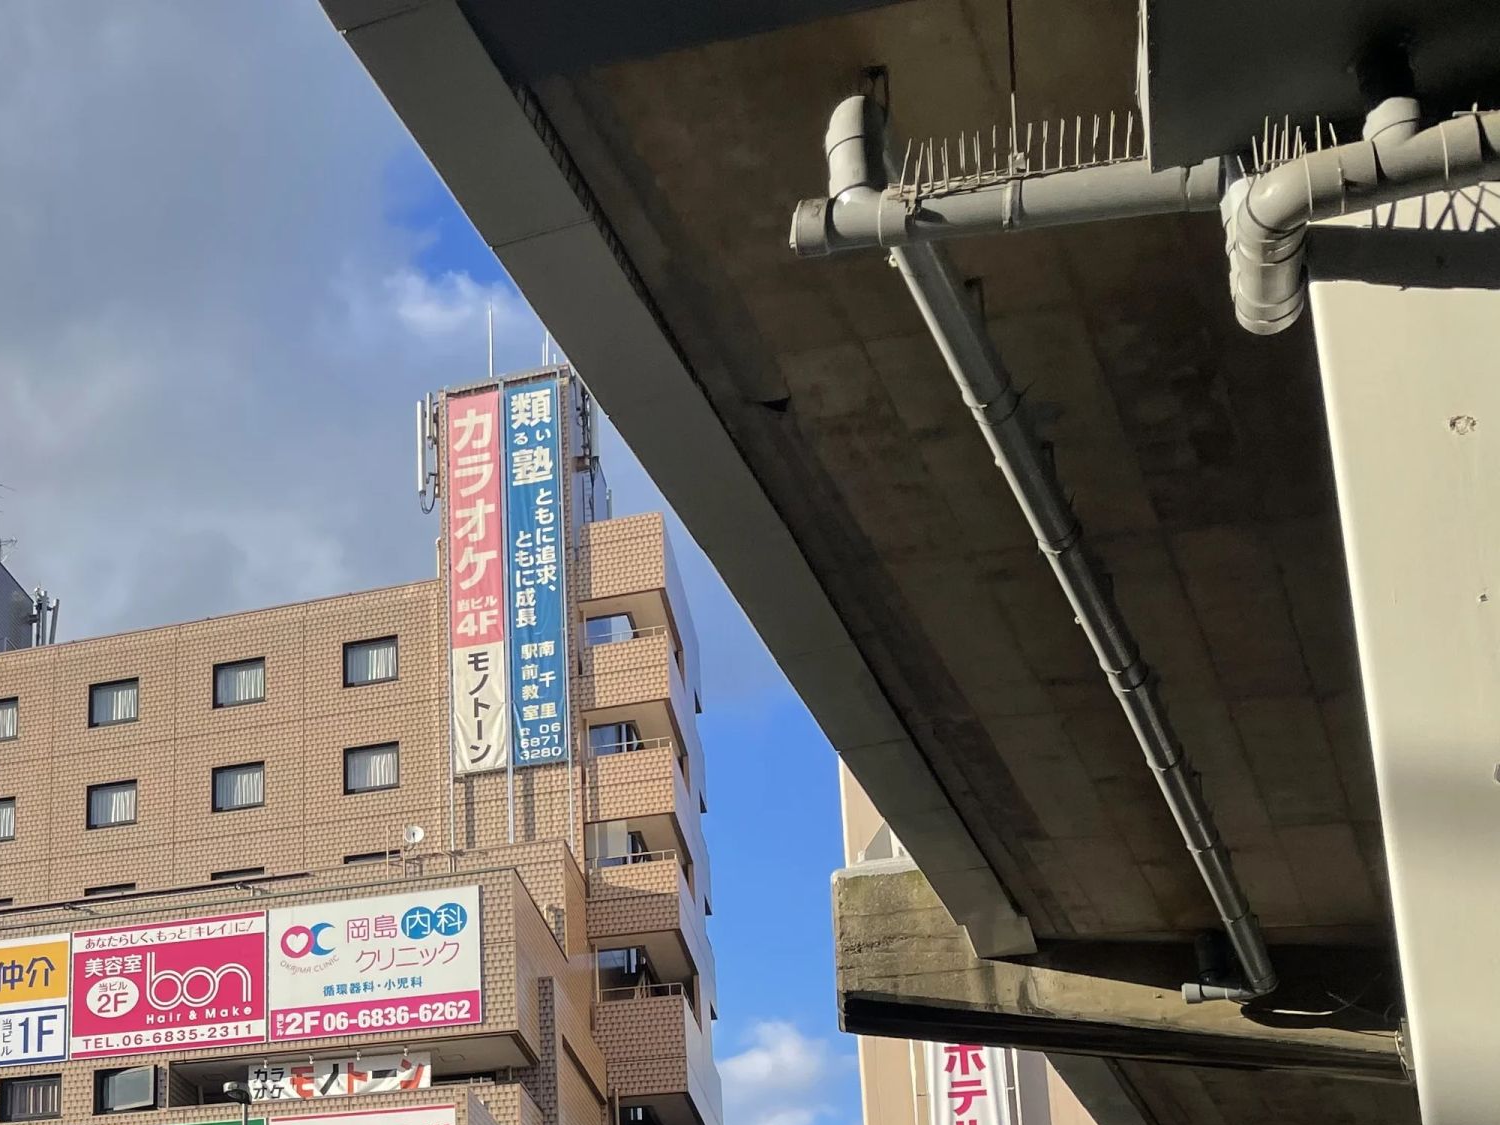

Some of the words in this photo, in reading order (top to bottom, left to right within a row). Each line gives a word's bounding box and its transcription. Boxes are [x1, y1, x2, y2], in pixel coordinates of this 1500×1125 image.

[453, 408, 498, 590] カラオケ
[515, 530, 537, 629] ともに成長
[456, 594, 498, 613] 当ビル
[456, 608, 499, 638] 4F
[538, 640, 558, 720] 南千里
[467, 651, 492, 764] モノトーン
[539, 722, 562, 735] 06
[520, 747, 563, 761] 3280
[346, 904, 464, 943] 岡島内科
[85, 954, 143, 979] 美容室
[313, 954, 340, 973] CLINIC
[355, 941, 460, 973] クリニック
[99, 980, 128, 992] 当ビル
[146, 951, 252, 1011] bon
[323, 976, 423, 997] 循環器科・小児科
[97, 992, 129, 1014] 2F
[146, 1012, 182, 1025] Hair
[188, 1010, 198, 1021] &
[205, 1006, 252, 1020] Make
[322, 1000, 471, 1032] 06-6836-6262
[18, 1015, 58, 1054] 1F
[285, 1011, 321, 1036] 2F
[1, 1019, 13, 1057] 当ビル
[253, 1067, 285, 1083] カラ
[290, 1058, 426, 1100] モノトーン
[253, 1085, 285, 1100] オケ
